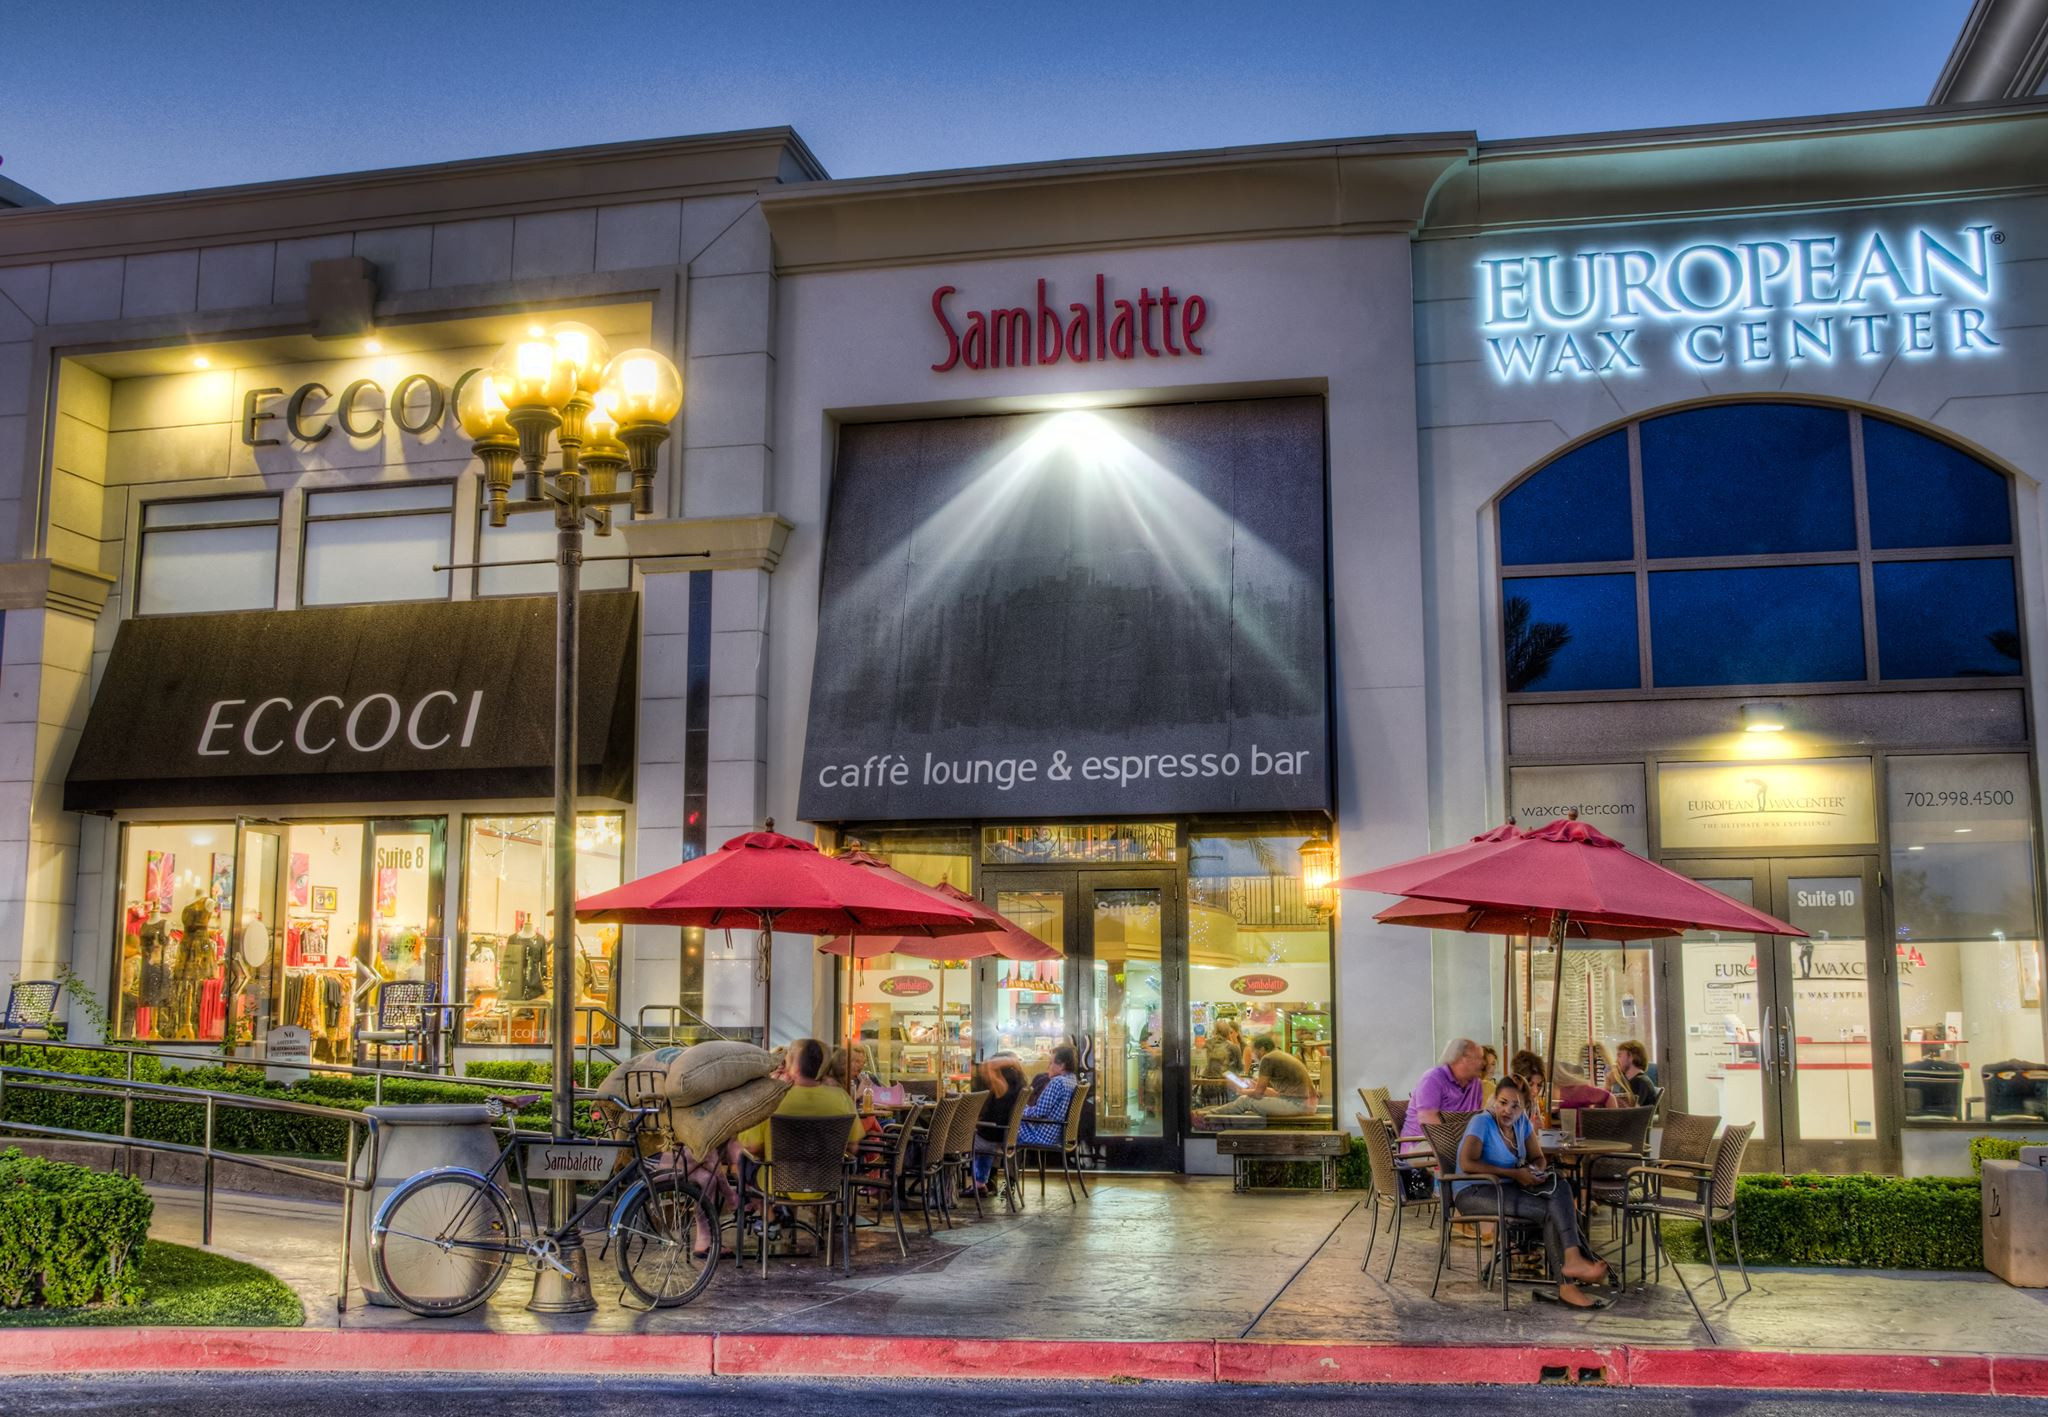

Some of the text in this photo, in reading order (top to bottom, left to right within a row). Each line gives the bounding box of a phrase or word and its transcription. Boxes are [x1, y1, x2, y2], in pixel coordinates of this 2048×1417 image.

[1480, 225, 1994, 328] EUROPEAN
[930, 273, 1207, 372] Sambalatte
[1486, 308, 2001, 377] WAX CENTER
[197, 690, 484, 756] ECCOCI
[818, 744, 1310, 791] caffè lounge & espresso bar
[1904, 790, 2015, 807] 702.998.4500
[377, 846, 424, 870] Suite 8
[1797, 889, 1855, 907] Suite 10
[544, 1150, 603, 1171] Sambalatte
